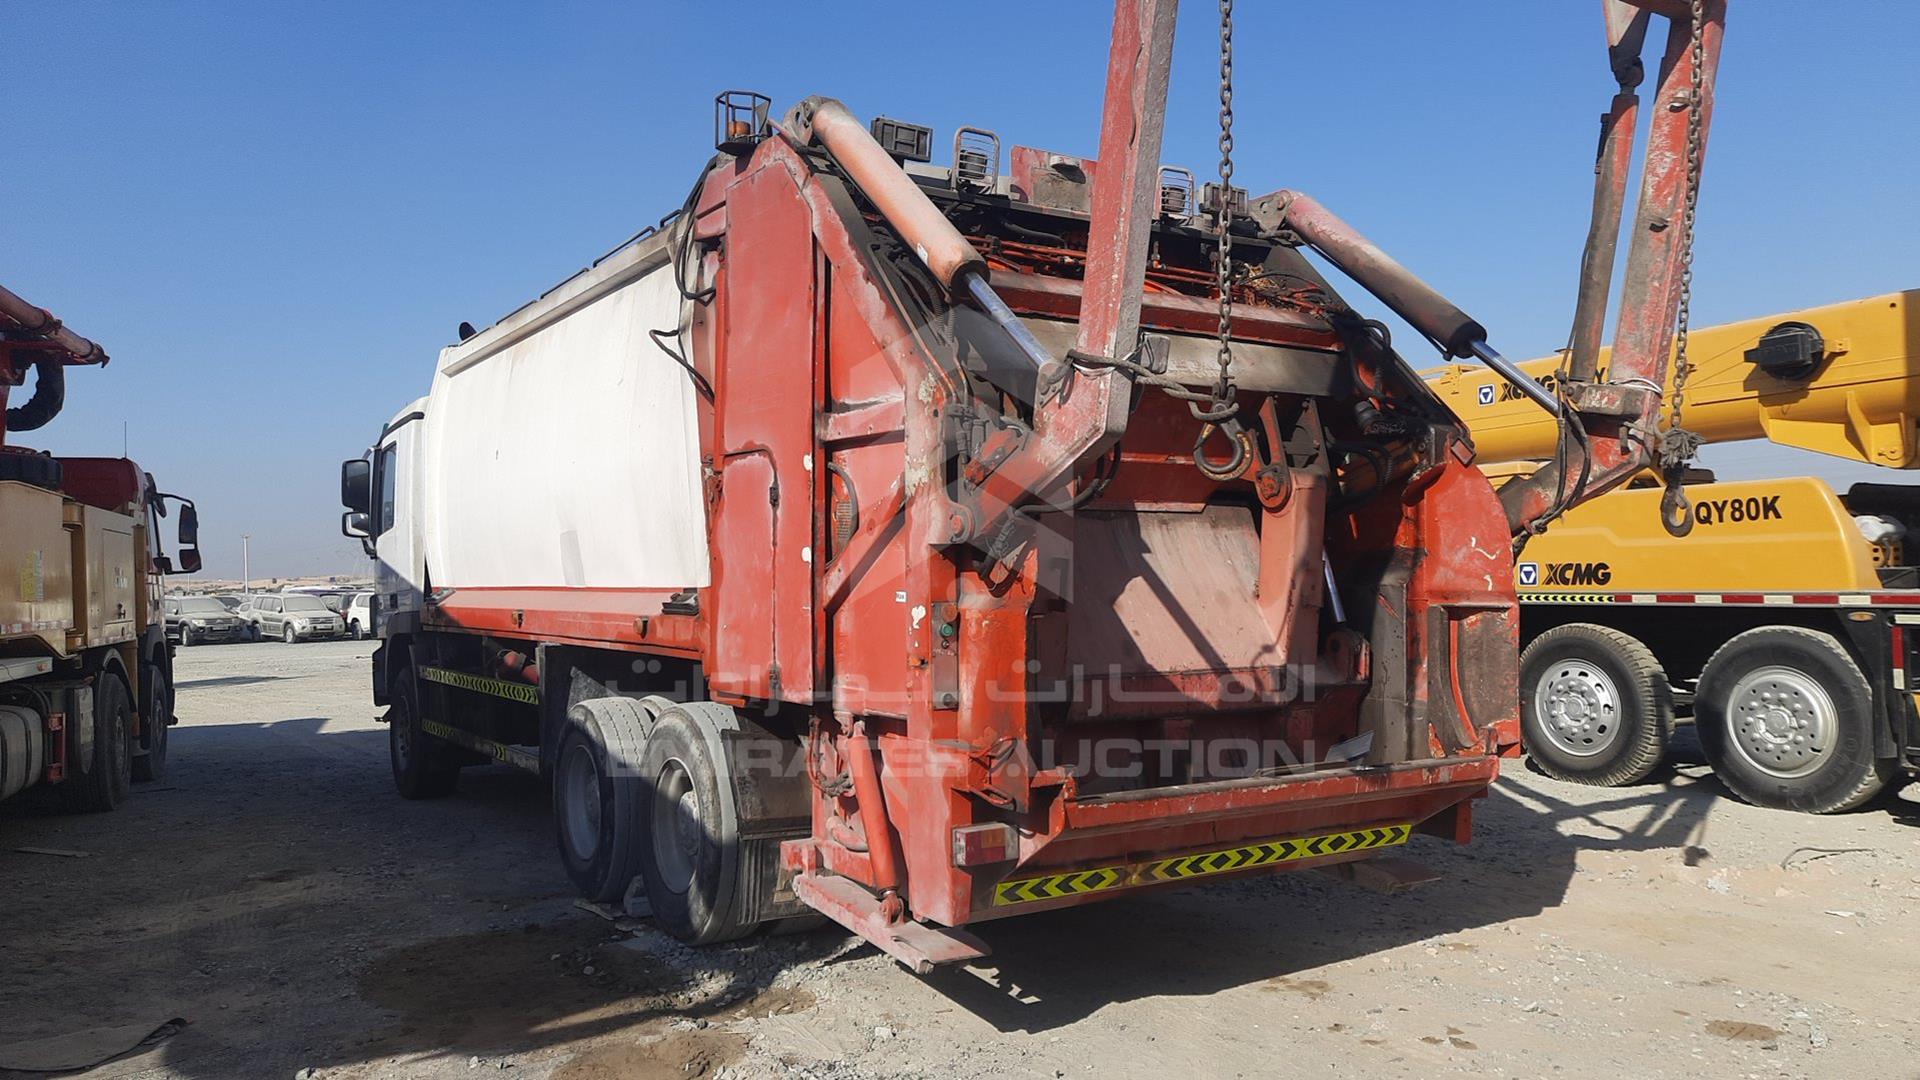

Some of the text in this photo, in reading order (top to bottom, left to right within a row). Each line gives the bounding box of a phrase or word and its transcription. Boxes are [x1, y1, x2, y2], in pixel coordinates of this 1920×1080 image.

[1498, 375, 1556, 402] XCG
[1694, 495, 1783, 525] QY80K
[1541, 562, 1612, 586] XCMG
